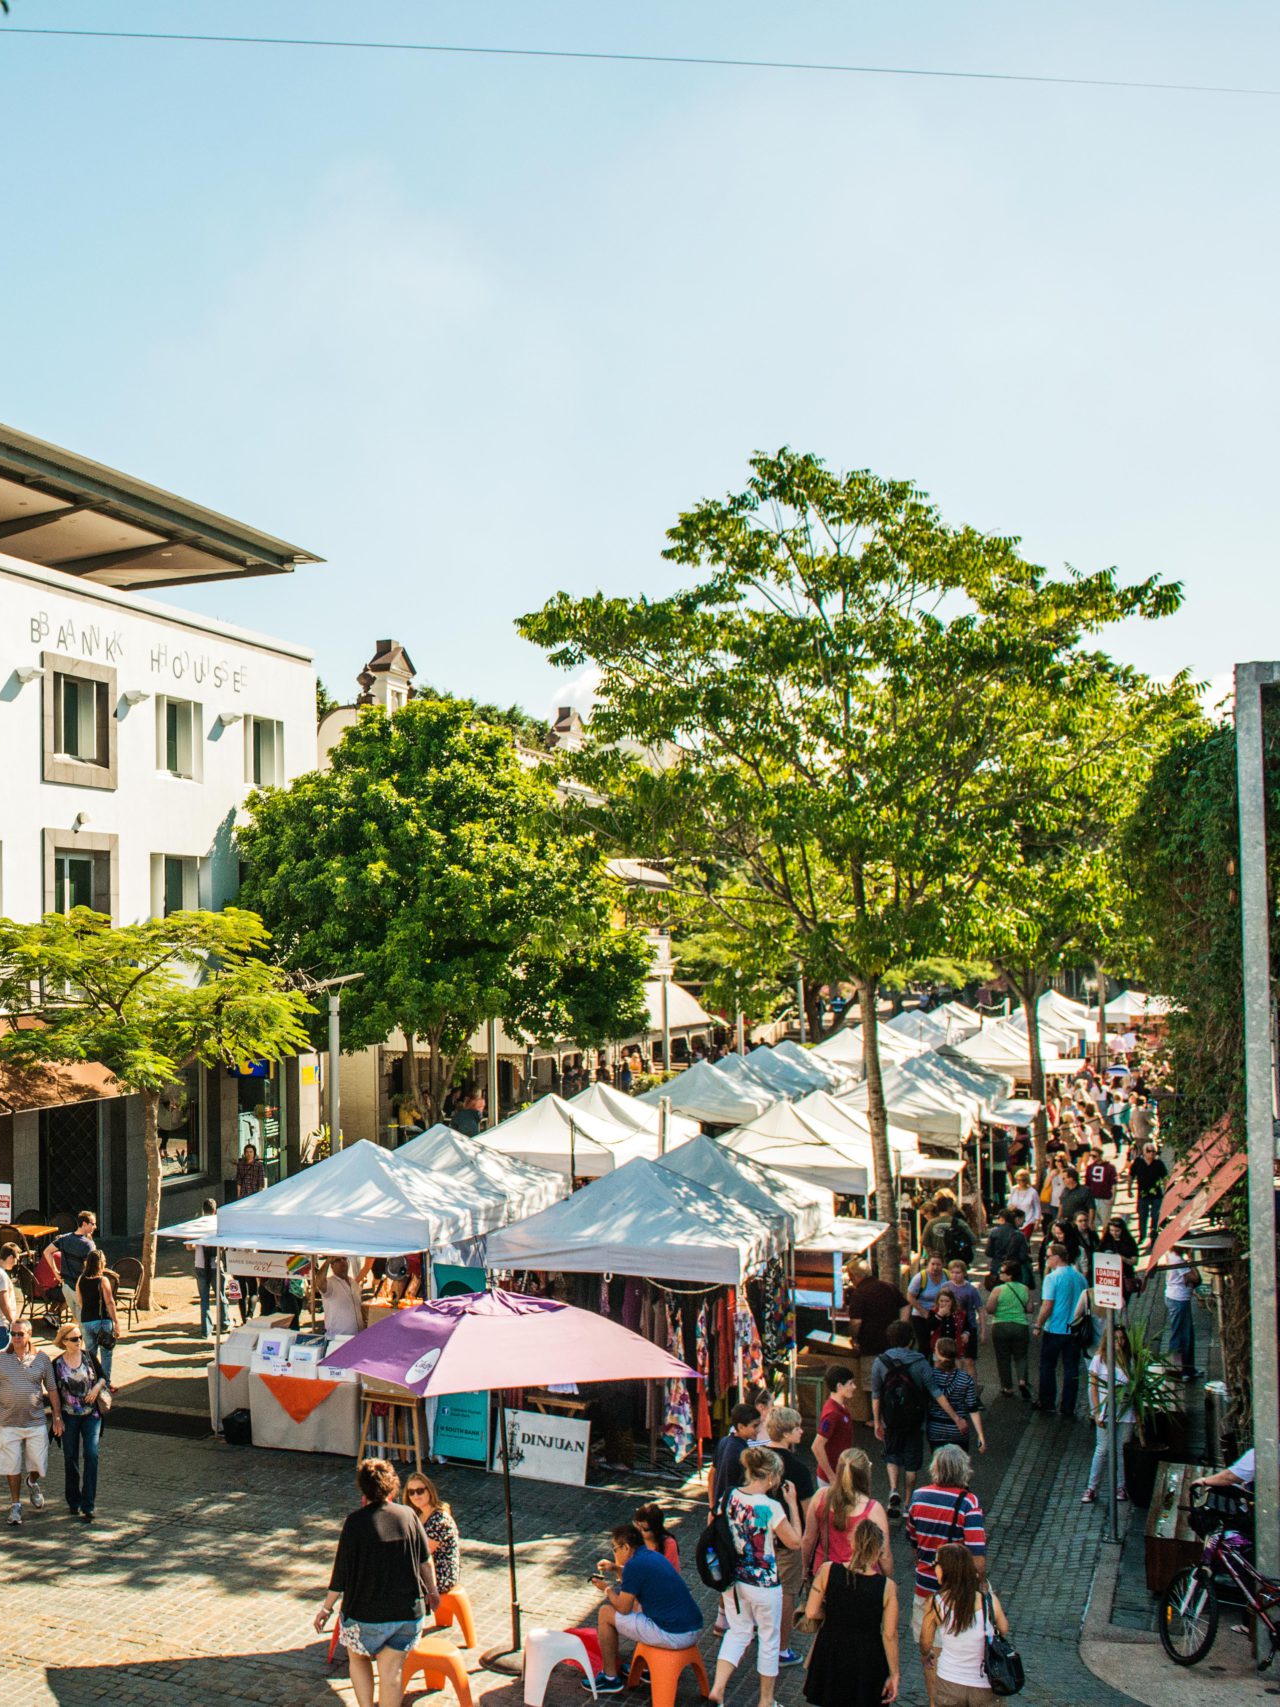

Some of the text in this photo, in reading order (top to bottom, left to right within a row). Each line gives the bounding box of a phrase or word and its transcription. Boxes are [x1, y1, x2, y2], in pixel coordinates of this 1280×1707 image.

[29, 616, 117, 661] BANK
[149, 649, 241, 694] HOUSE
[1092, 1165, 1105, 1183] 9
[1096, 1267, 1120, 1278] LOADING
[1098, 1276, 1118, 1287] ZONE
[521, 1432, 586, 1453] DINJUAN
